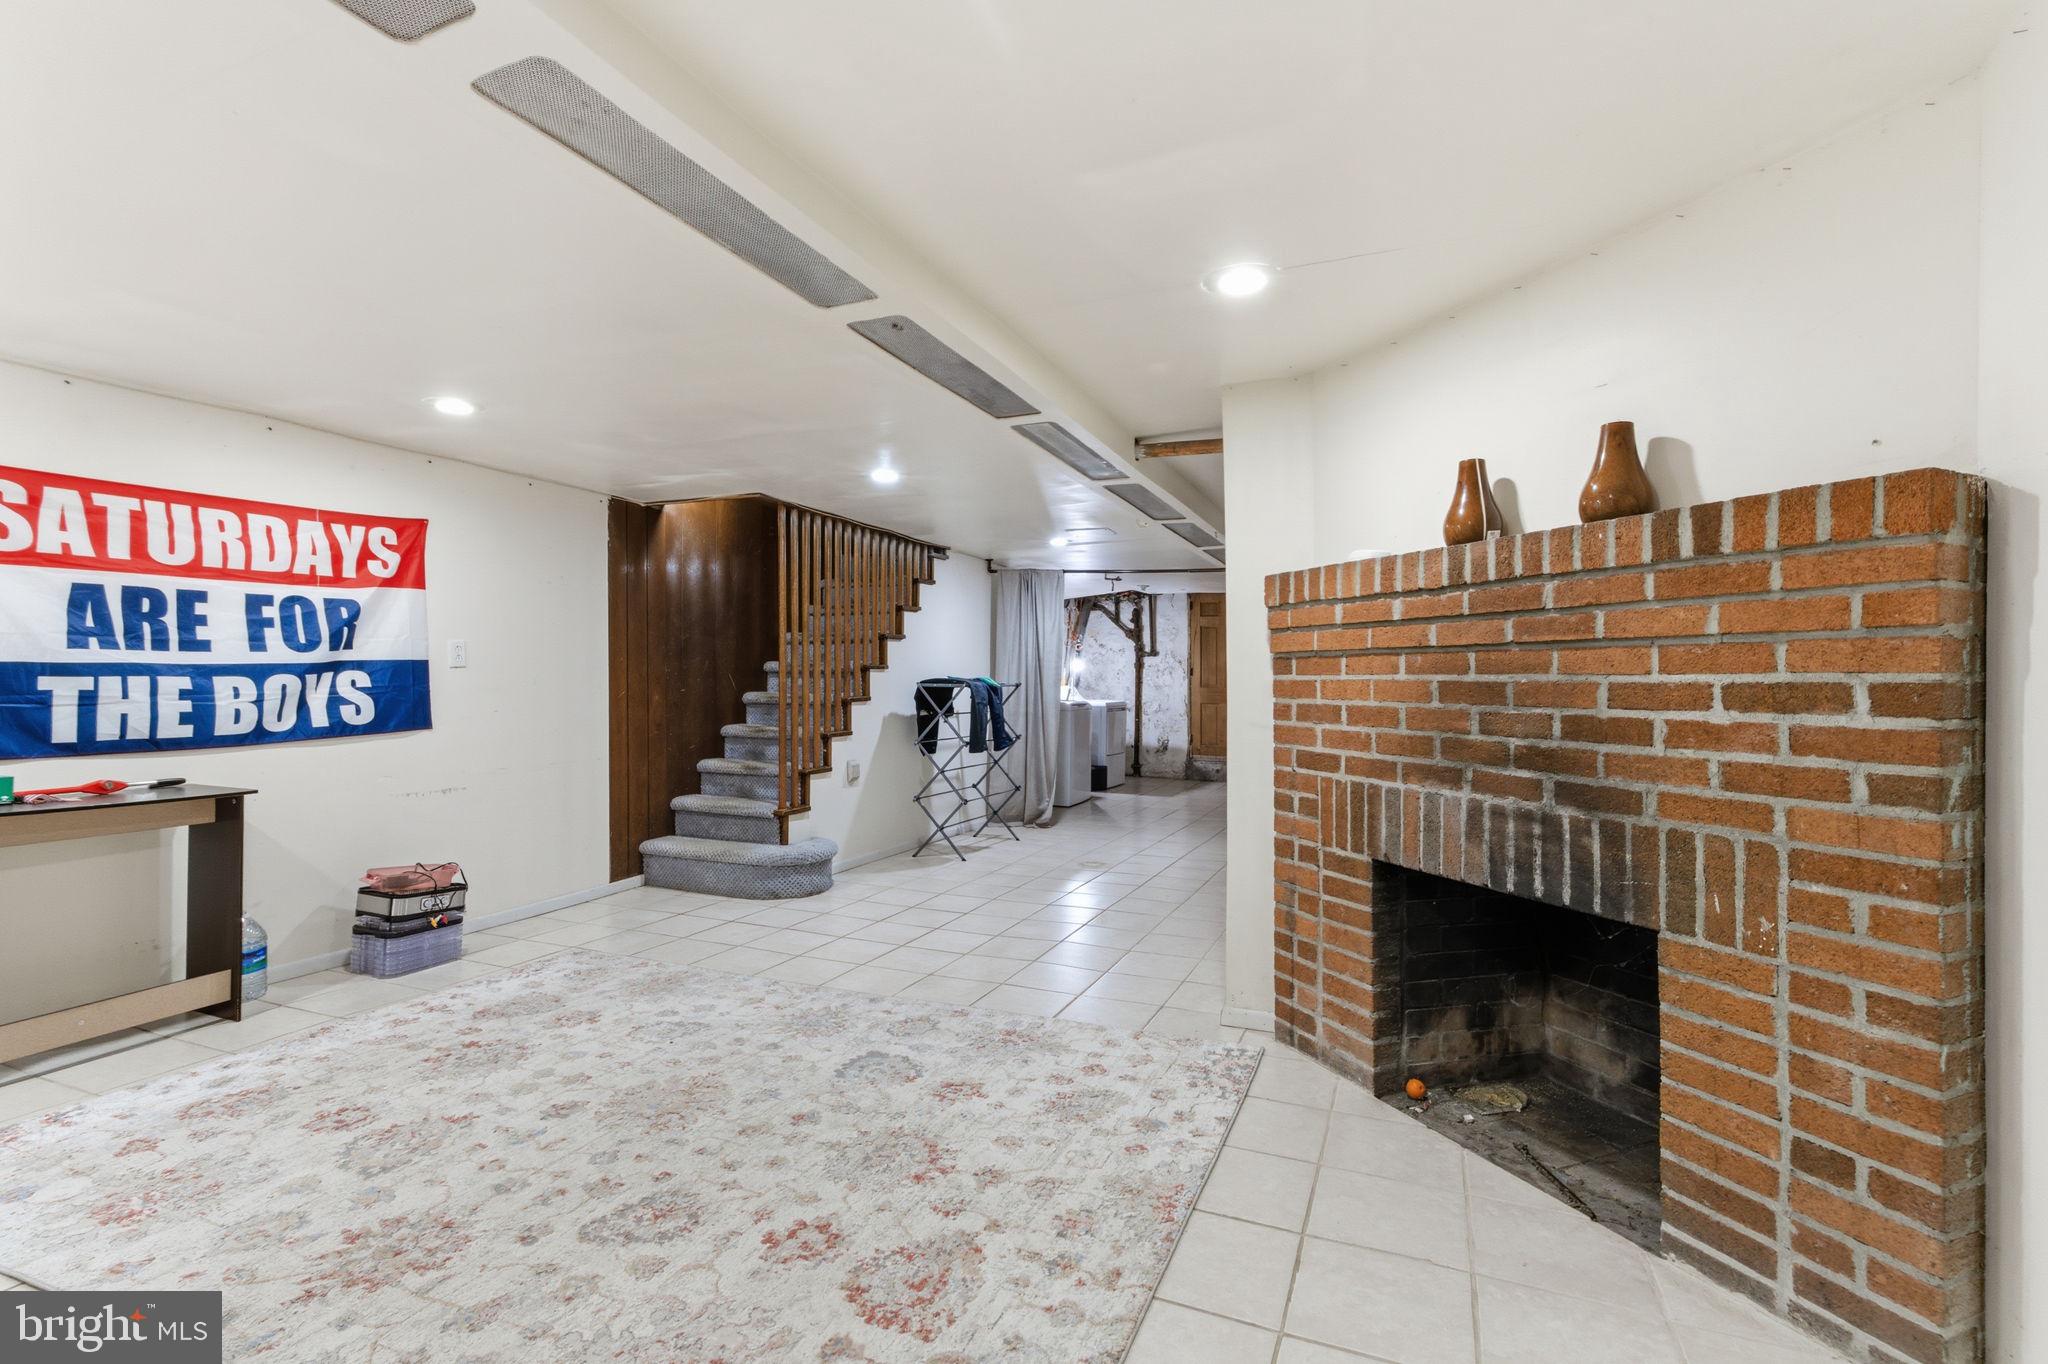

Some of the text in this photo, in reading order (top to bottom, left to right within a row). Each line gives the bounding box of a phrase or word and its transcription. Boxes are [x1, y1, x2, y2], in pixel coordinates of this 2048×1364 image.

[0, 479, 401, 579] SATURDAYS
[66, 582, 361, 653] ARE FOR
[37, 670, 375, 744] THE BOYS
